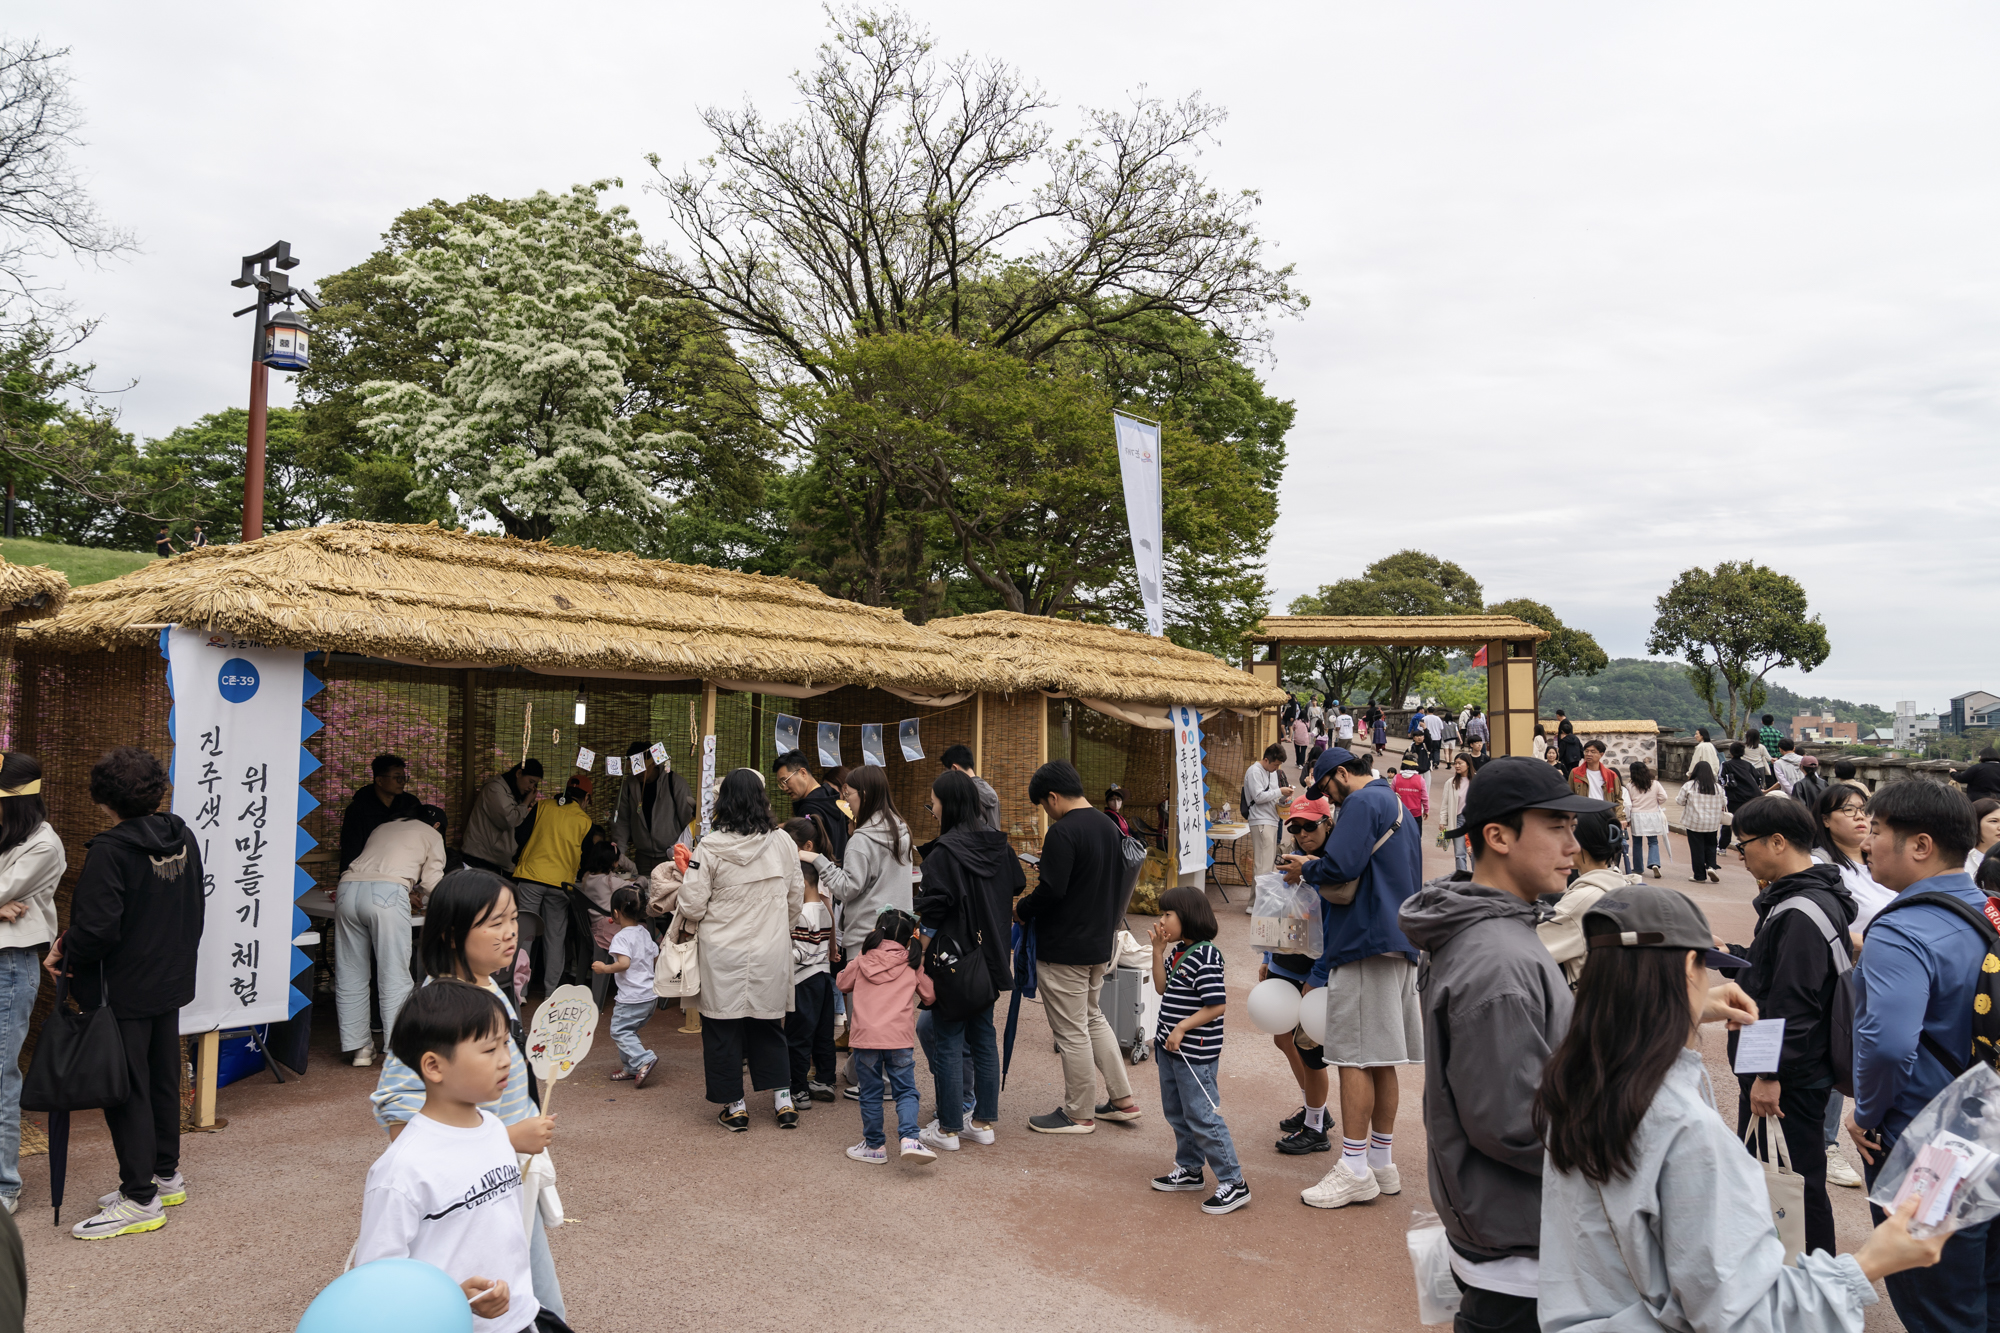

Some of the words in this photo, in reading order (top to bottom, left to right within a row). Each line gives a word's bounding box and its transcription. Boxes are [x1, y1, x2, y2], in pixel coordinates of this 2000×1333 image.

[221, 675, 255, 686] C존-39
[1190, 747, 1201, 833] 급수봉사
[1180, 747, 1191, 857] 종합안내소
[233, 762, 269, 928] 위성만들기
[229, 939, 259, 1007] 체험
[548, 1006, 587, 1024] EVERY
[557, 1021, 576, 1034] DAY
[551, 1033, 573, 1044] THANK
[553, 1043, 568, 1055] YOU
